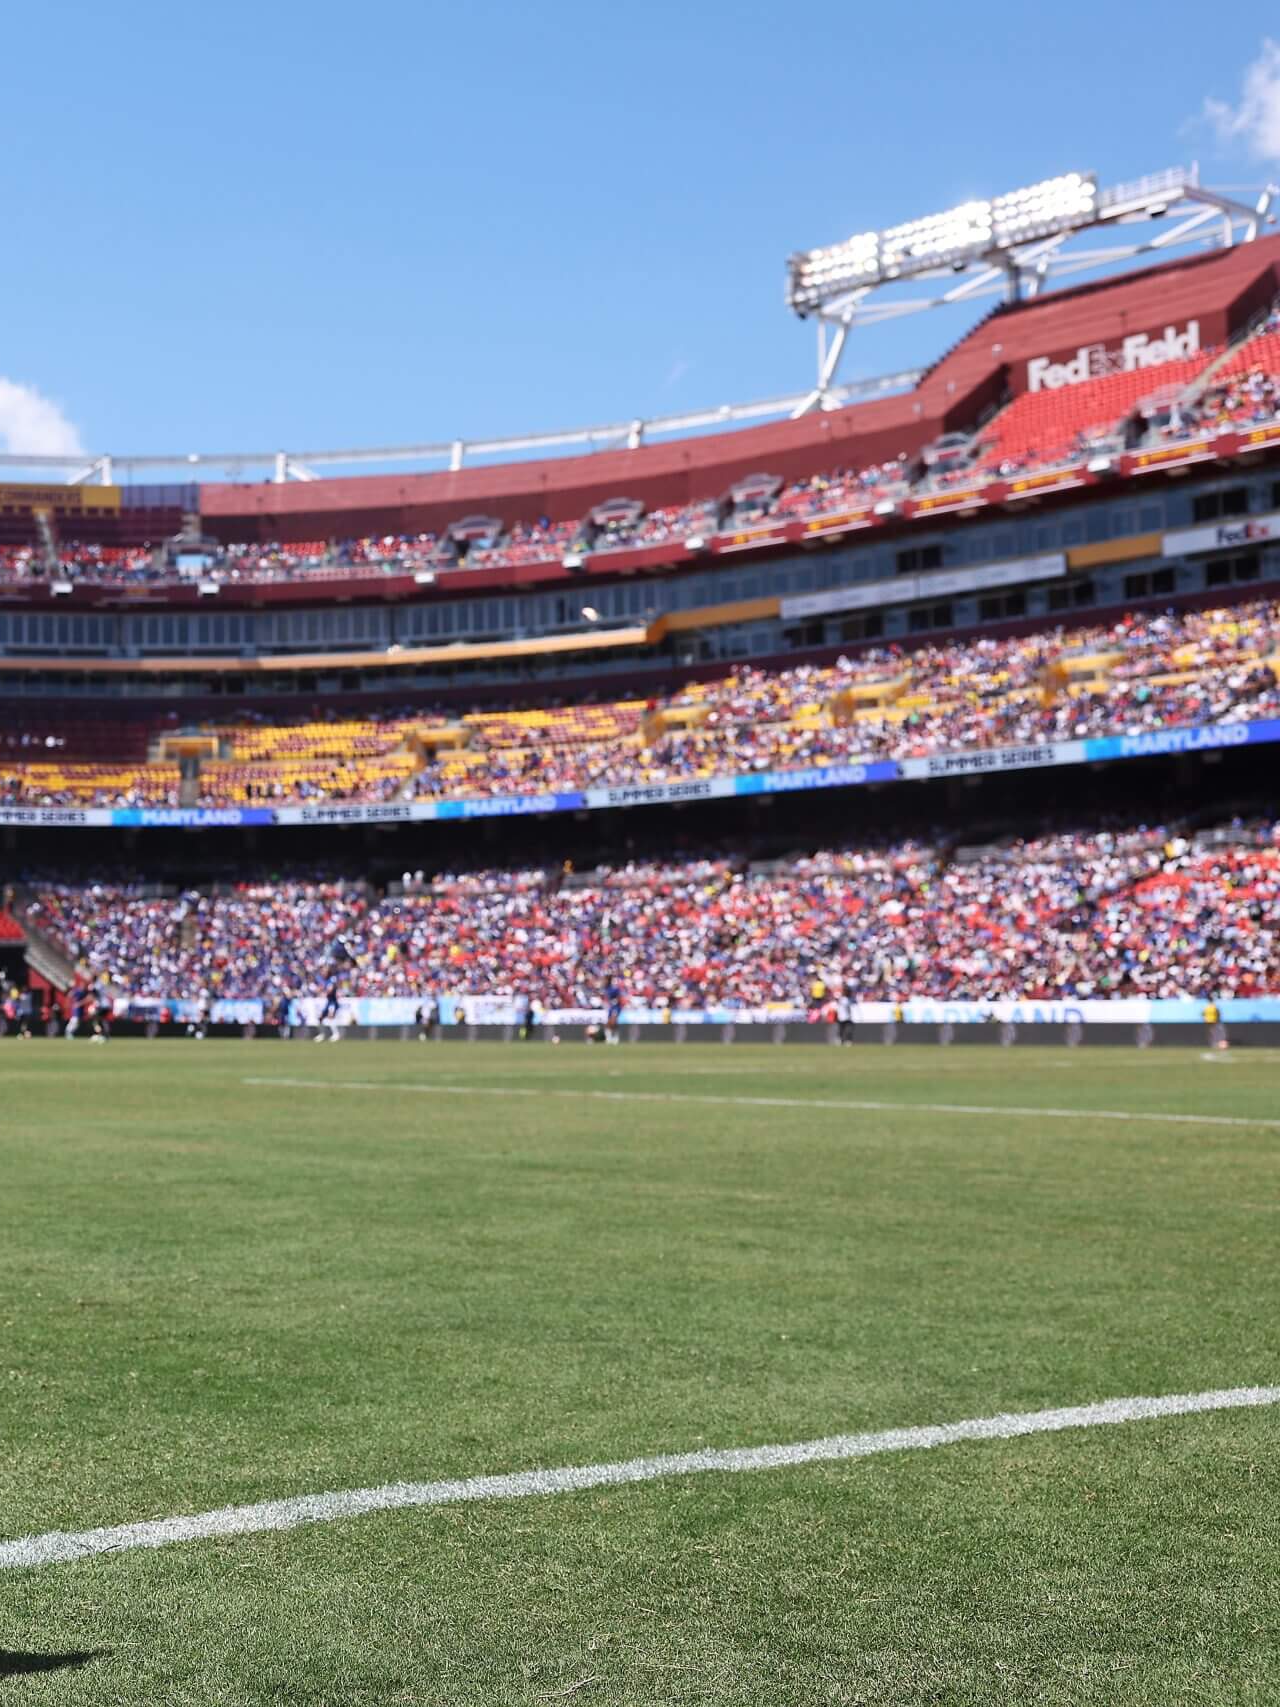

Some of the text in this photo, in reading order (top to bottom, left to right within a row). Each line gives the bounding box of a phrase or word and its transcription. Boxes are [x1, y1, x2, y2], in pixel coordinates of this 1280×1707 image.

[1121, 725, 1249, 756] MARYLAND
[763, 767, 867, 792] MARYLAND
[142, 808, 243, 825] MARYLAND
[463, 796, 557, 817] MARYLAND
